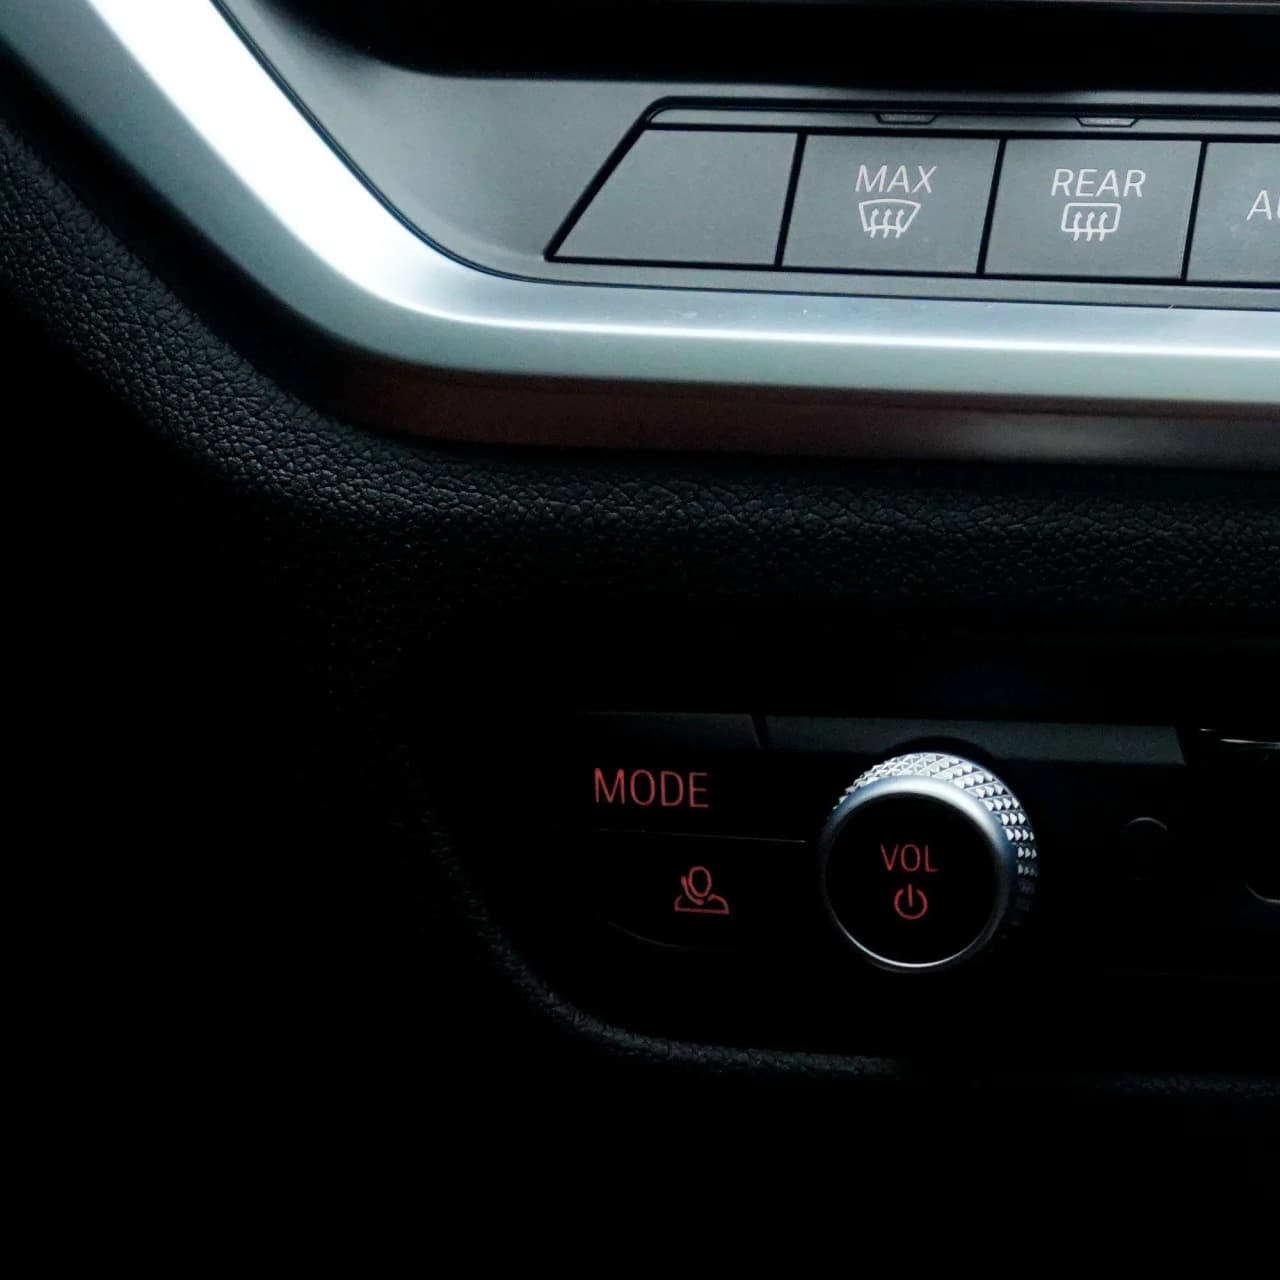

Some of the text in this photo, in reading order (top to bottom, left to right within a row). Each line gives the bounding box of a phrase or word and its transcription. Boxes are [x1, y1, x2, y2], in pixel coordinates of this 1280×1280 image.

[854, 164, 937, 194] MAX
[1051, 168, 1147, 198] REAR
[594, 767, 710, 809] MODE
[880, 843, 939, 873] VOL
